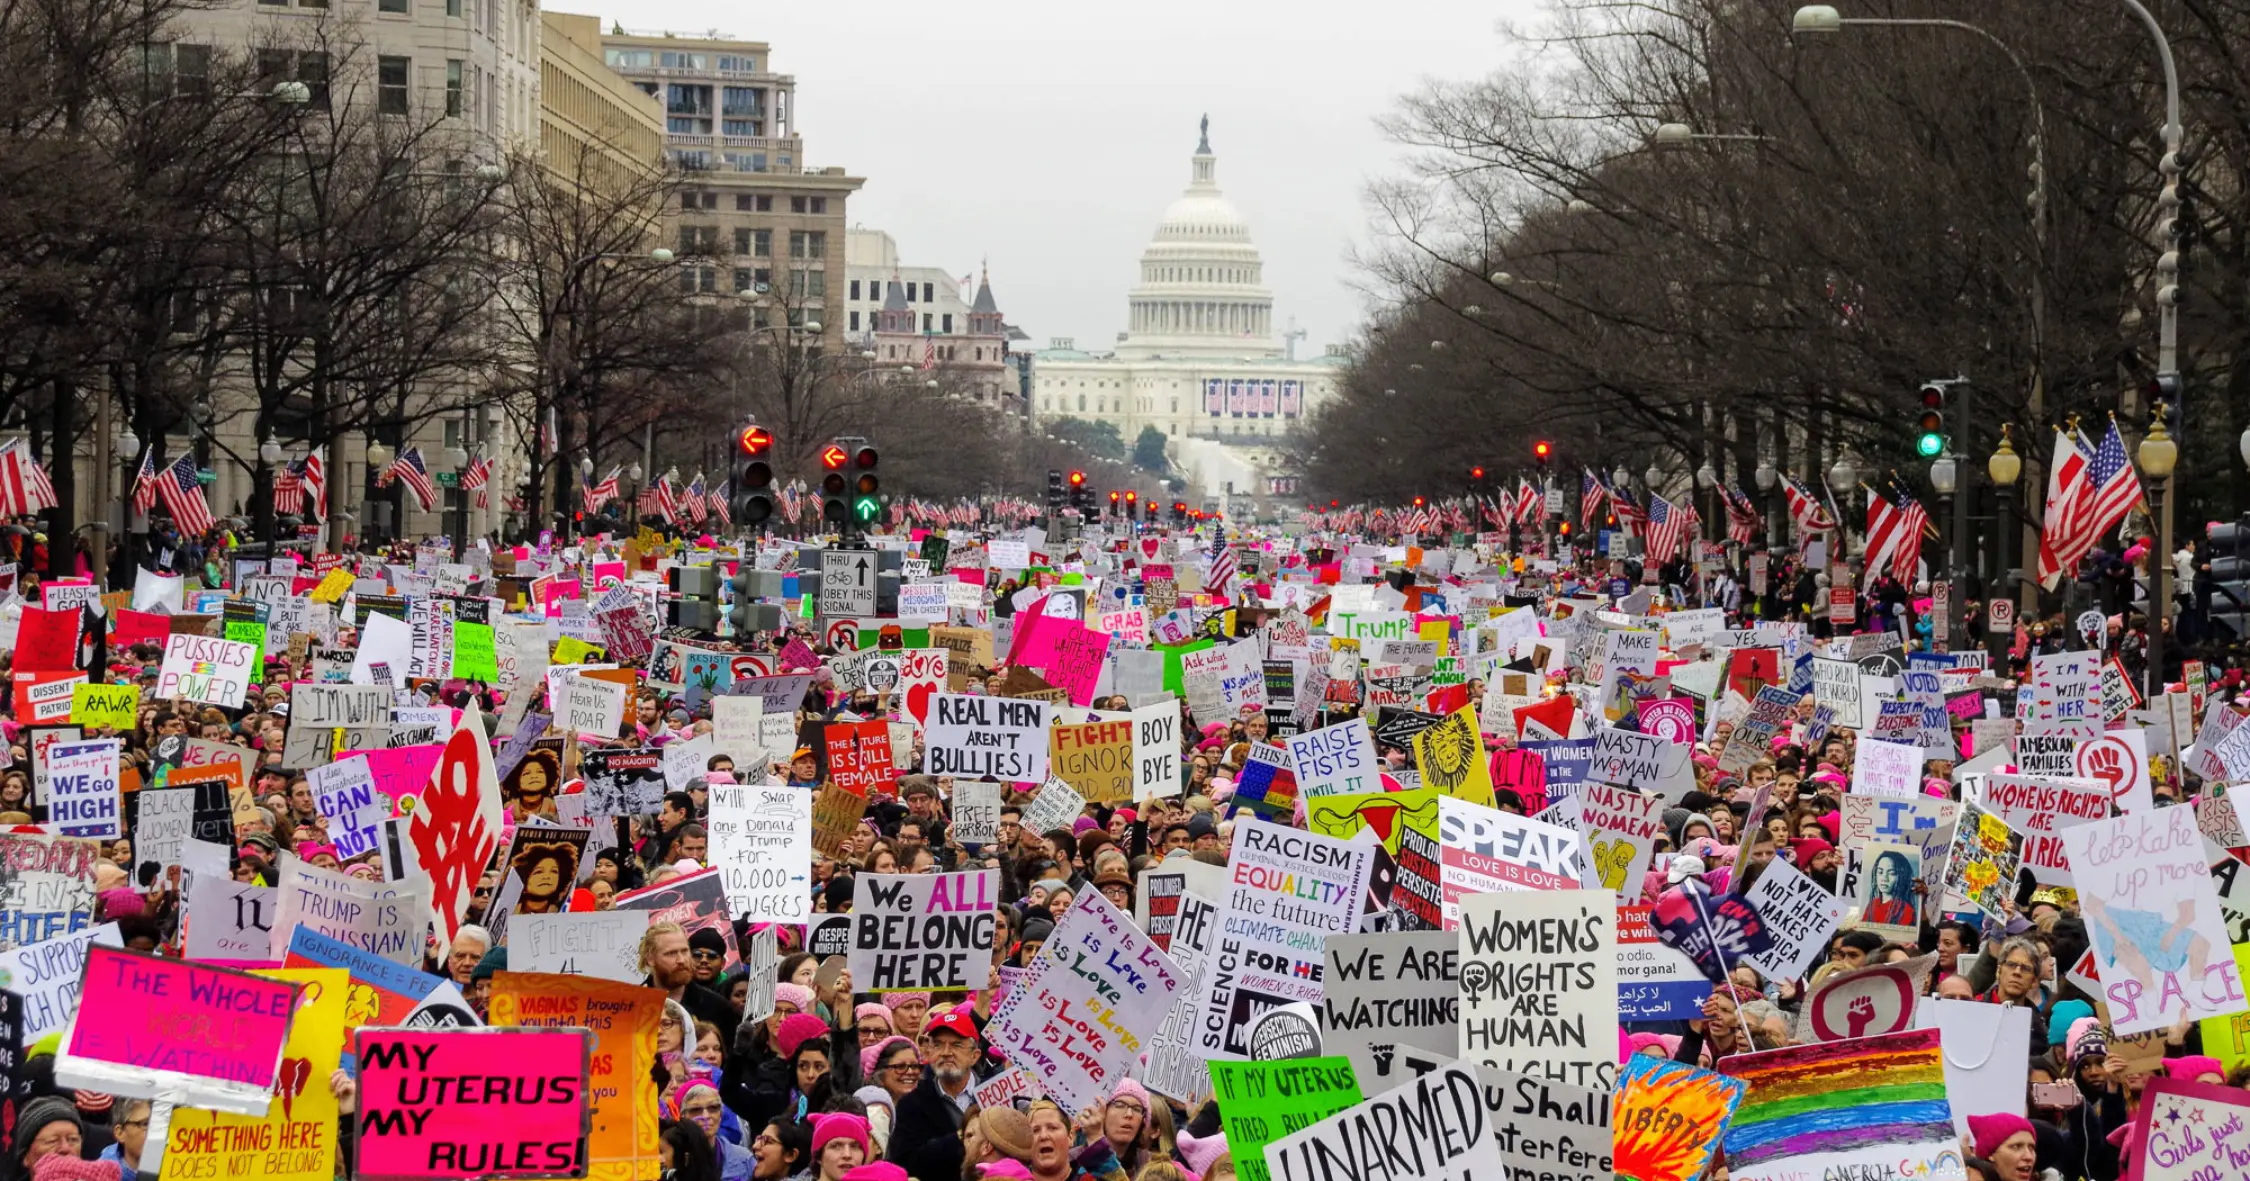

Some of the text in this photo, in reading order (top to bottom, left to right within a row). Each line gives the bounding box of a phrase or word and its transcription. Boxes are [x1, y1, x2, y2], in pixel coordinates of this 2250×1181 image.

[826, 555, 850, 566] THRU
[57, 587, 89, 600] LEAST
[824, 589, 873, 600] OBEY THIS
[824, 601, 856, 613] SIGNAL
[1102, 611, 1143, 631] GRAB
[171, 635, 249, 667] PUSSIES
[407, 621, 428, 678] WILL ACT
[1617, 634, 1652, 650] MAKE
[1734, 631, 1757, 645] YES
[1185, 656, 1205, 670] Ask
[2056, 664, 2079, 675] I'M
[33, 682, 70, 698] DISSENT
[162, 671, 238, 706] POWER
[1758, 685, 1800, 706] KEEP
[1903, 673, 1939, 693] VOTED
[2056, 683, 2086, 697] WITH
[84, 695, 132, 713] RAWR
[344, 689, 390, 723] WITH
[570, 690, 592, 706] HEAR
[1755, 699, 1788, 716] YOUR
[2058, 700, 2084, 717] HER
[569, 709, 606, 730] ROAR
[939, 697, 1041, 729] REAL MEN
[1642, 707, 1693, 730] UNITED STAND
[406, 726, 437, 745] CHANGE
[829, 739, 847, 749] THE
[965, 731, 1020, 749] AREN'T
[1055, 722, 1132, 750] FIGHT
[1142, 716, 1173, 746] BOY
[1293, 724, 1363, 761] RAISE
[1808, 723, 1826, 741] NO
[1252, 744, 1280, 766] THIS
[1552, 746, 1593, 761] WOMEN
[1596, 732, 1664, 759] NASTY
[608, 756, 657, 766] NO MAJORITY
[831, 753, 845, 767] IS
[931, 749, 1033, 777] BULLIES!
[1143, 754, 1172, 785] BYE
[1299, 748, 1360, 781] FISTS
[1559, 766, 1572, 777] THE
[1592, 755, 1659, 782] WOMAN
[2022, 754, 2073, 771] FAMILIES
[53, 774, 114, 795] WE GO
[834, 767, 893, 787] FEMALE
[1305, 776, 1363, 799] UNTIL IT
[53, 797, 115, 822] HIGH
[142, 791, 190, 817] BLACK
[319, 783, 371, 818] CAN
[714, 788, 746, 809] Will
[1587, 785, 1657, 817] NASTY
[2056, 784, 2111, 819] RIGHTS
[341, 811, 357, 832] U
[714, 819, 795, 834] one Donald
[955, 805, 994, 825] FREE
[1876, 801, 1937, 835] I'm
[2027, 811, 2053, 831] ARE
[141, 819, 188, 841] WOMEN
[334, 824, 378, 860] NOT
[745, 835, 794, 849] Trump
[954, 822, 999, 838] BARRON
[1243, 827, 1351, 870] RACISM
[1440, 811, 1580, 881] SPEAK
[1234, 862, 1348, 905] EQUALITY
[1350, 852, 1365, 897] PLANNED
[1447, 870, 1514, 893] NO HUMAN
[1462, 853, 1562, 890] LOVE IS LOVE
[2111, 860, 2207, 907] up more
[868, 872, 994, 913] We ALL
[1150, 881, 1183, 897] PROLONGED
[298, 889, 398, 926] TRUMP IS
[1231, 888, 1341, 931] the future
[1761, 878, 1830, 934] NOT HATE
[857, 913, 995, 949] BELONG
[1224, 917, 1285, 944] CLIMATE
[1464, 906, 1603, 955] WOMEN'S
[1758, 900, 1809, 942] MAKES
[528, 919, 623, 957] FIGHT
[1086, 930, 1102, 954] is
[1122, 932, 1135, 951] is
[298, 932, 390, 980] IGNORANCE
[1244, 948, 1290, 976] FOR
[1332, 945, 1459, 982] WE ARE
[1627, 949, 1656, 962] odio.
[872, 953, 968, 989] HERE
[1052, 937, 1122, 1006] is Love
[1490, 961, 1596, 1001] RIGHTS
[1642, 961, 1676, 978] gana!
[107, 955, 290, 1018] THE WHOLE
[1203, 938, 1240, 1051] SCIENCE
[2105, 959, 2245, 1026] SPACE
[520, 995, 635, 1014] VAGINAS brought
[1326, 996, 1460, 1030] WATCHING
[1510, 993, 1558, 1017] ARE
[584, 1014, 612, 1030] this
[1038, 988, 1107, 1053] is Love
[1084, 997, 1141, 1053] is Love
[1466, 1014, 1587, 1050] HUMAN
[362, 1041, 440, 1072] MY
[1001, 1019, 1058, 1077] is Love
[1041, 1020, 1106, 1083] is Love
[1255, 1033, 1314, 1060] FEMINISM
[398, 1075, 579, 1106] UTERUS
[593, 1086, 618, 1102] you
[977, 1070, 1026, 1101] PEOPLE
[1219, 1066, 1357, 1100] IF MY UTERUS
[1512, 1076, 1609, 1128] Shall
[361, 1107, 435, 1137] MY
[1231, 1116, 1269, 1143] FIRED
[1279, 1069, 1484, 1181] UNARMED
[170, 1121, 324, 1154] SOMETHING HERE
[2149, 1112, 2244, 1169] Girls just
[169, 1150, 324, 1178] DOES NOT BELONG
[428, 1136, 586, 1177] RULES!
[1899, 1158, 1937, 1179] GAY
